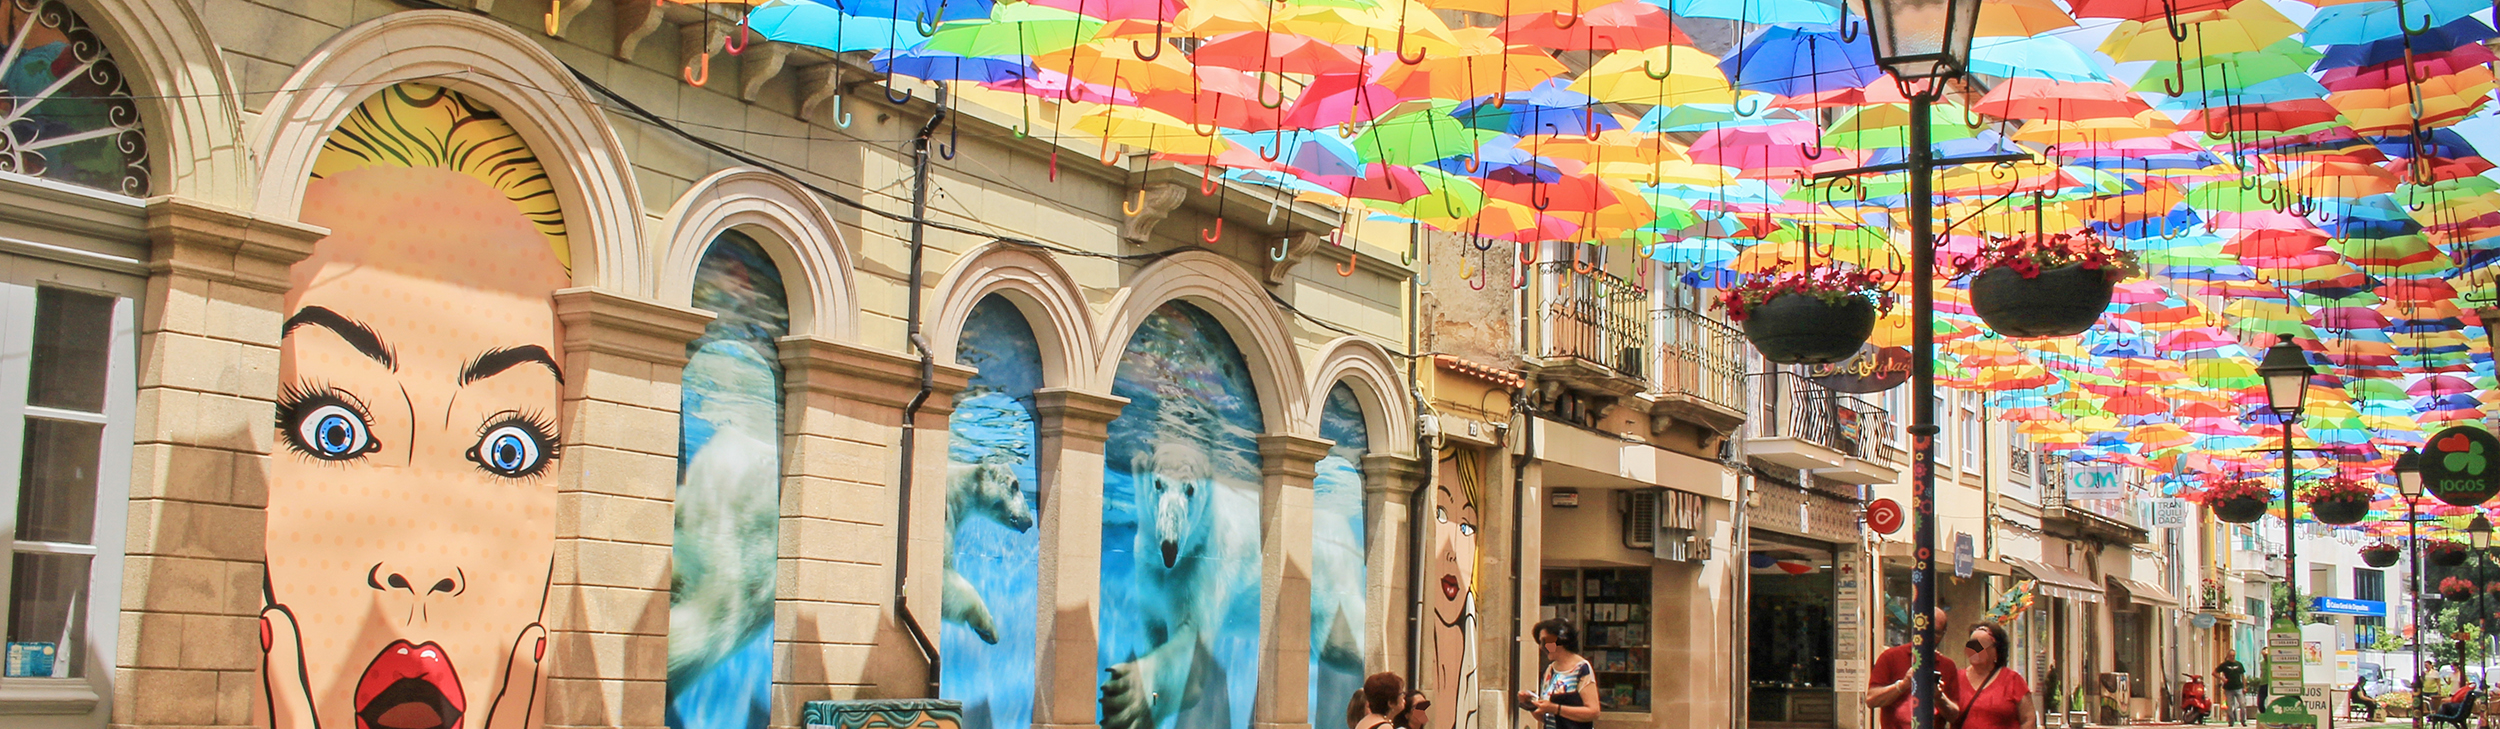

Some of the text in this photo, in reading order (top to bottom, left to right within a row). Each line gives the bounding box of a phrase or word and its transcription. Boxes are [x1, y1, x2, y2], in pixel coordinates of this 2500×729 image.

[2440, 479, 2485, 495] JOGOS
[2157, 501, 2182, 509] TRAN
[2157, 509, 2182, 517] QUILI
[2158, 517, 2182, 525] DADE
[2302, 688, 2322, 697] IJOS
[2304, 701, 2327, 710] TURA
